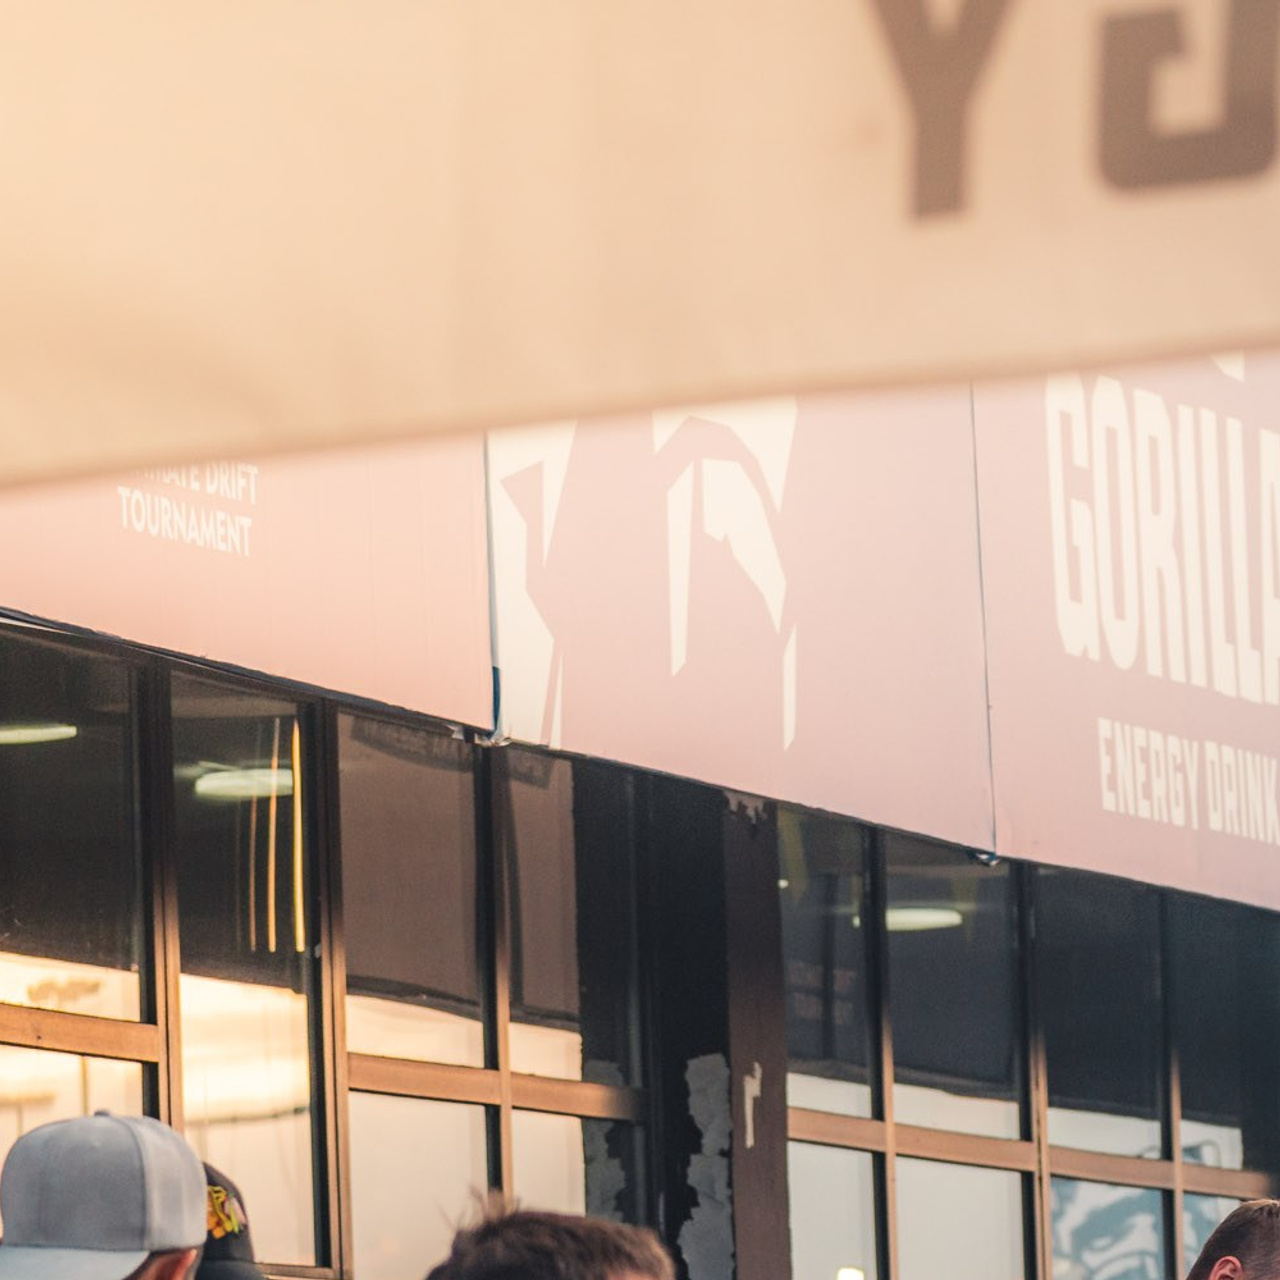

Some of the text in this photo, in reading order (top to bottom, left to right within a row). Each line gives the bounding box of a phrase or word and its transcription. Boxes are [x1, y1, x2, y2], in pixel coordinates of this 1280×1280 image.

[206, 460, 259, 505] DRIFT
[118, 485, 253, 557] TOURNAMENT
[1098, 717, 1200, 830] ENERGY
